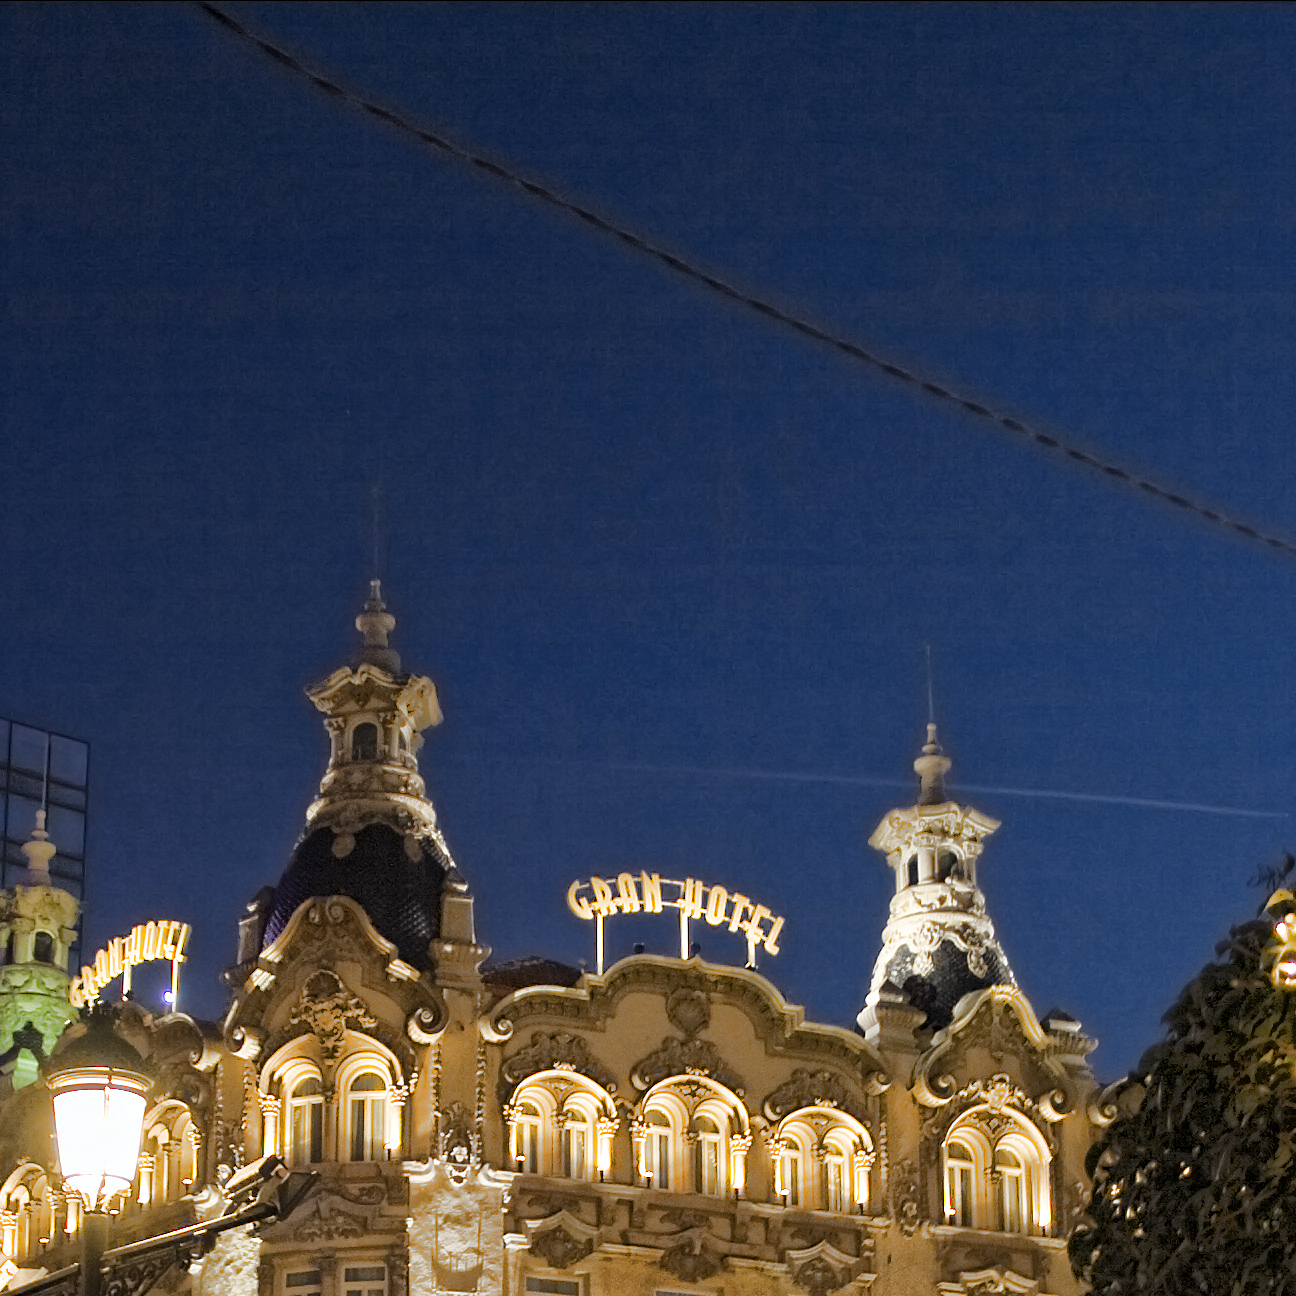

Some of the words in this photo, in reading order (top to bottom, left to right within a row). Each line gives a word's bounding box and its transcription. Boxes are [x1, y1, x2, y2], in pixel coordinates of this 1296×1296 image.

[567, 870, 663, 920] GRAN
[681, 877, 785, 957] HOTEL
[69, 936, 124, 1008] GRAN
[126, 920, 191, 966] HOTEL
